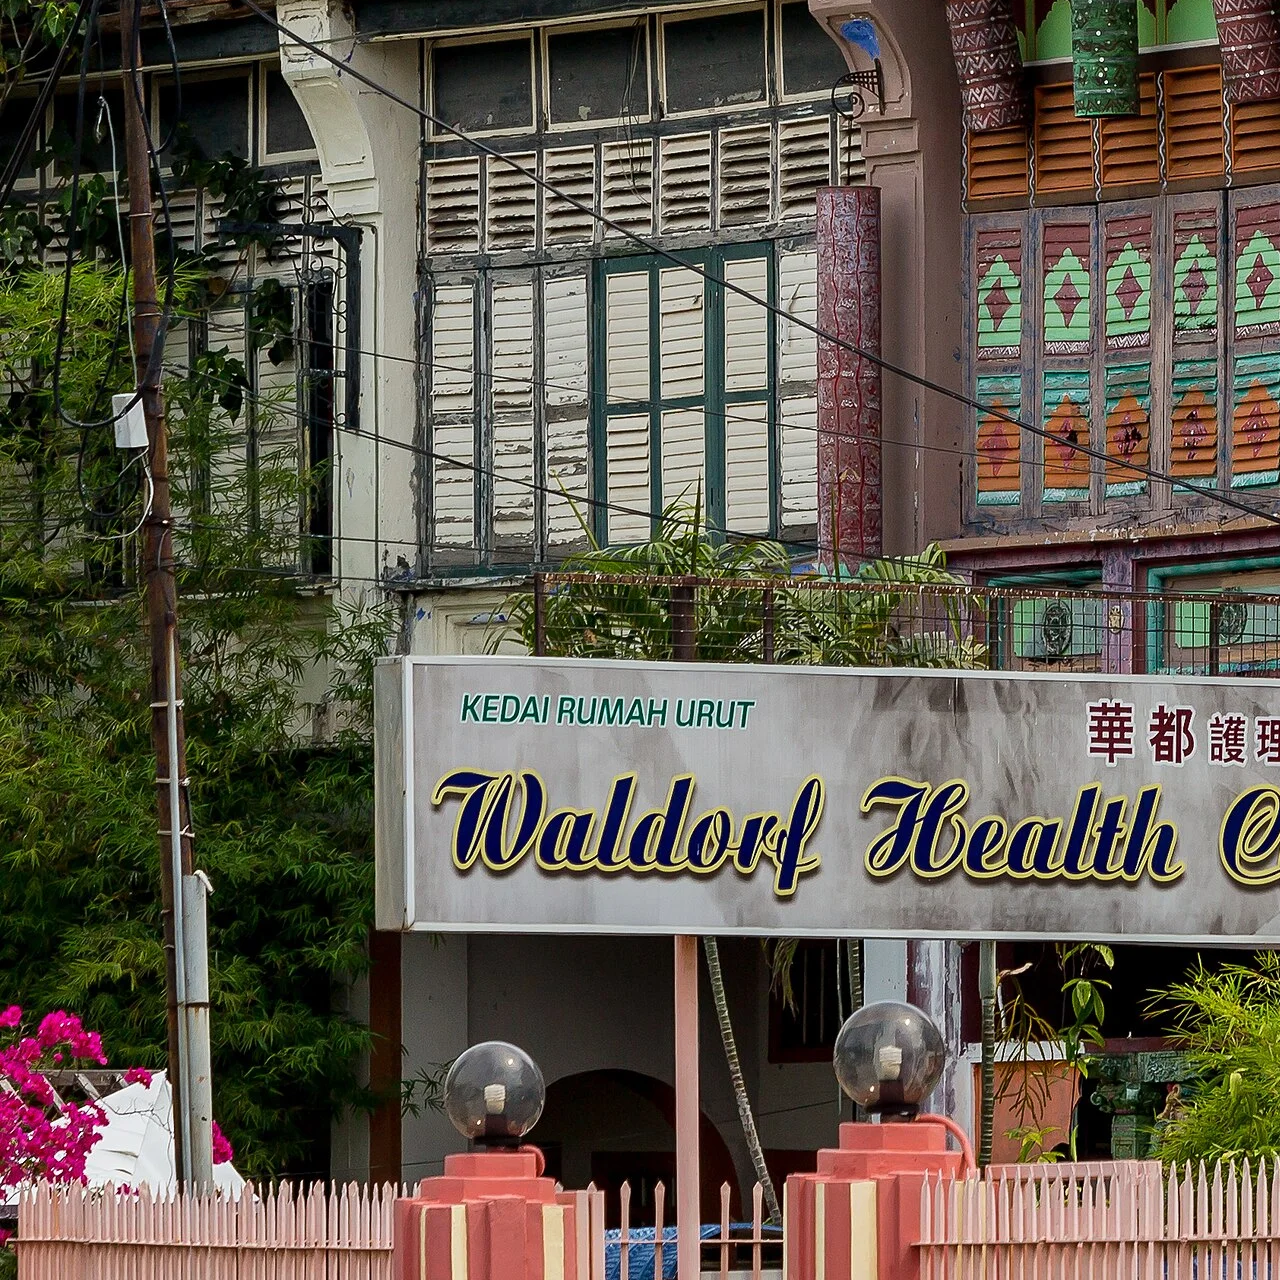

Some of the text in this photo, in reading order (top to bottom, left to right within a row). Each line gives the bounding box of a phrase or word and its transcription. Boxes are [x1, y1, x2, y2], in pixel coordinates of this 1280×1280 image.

[461, 694, 756, 729] KEDAI RUMAH URUT
[431, 767, 826, 897] Waldorf
[859, 775, 1184, 881] Health
